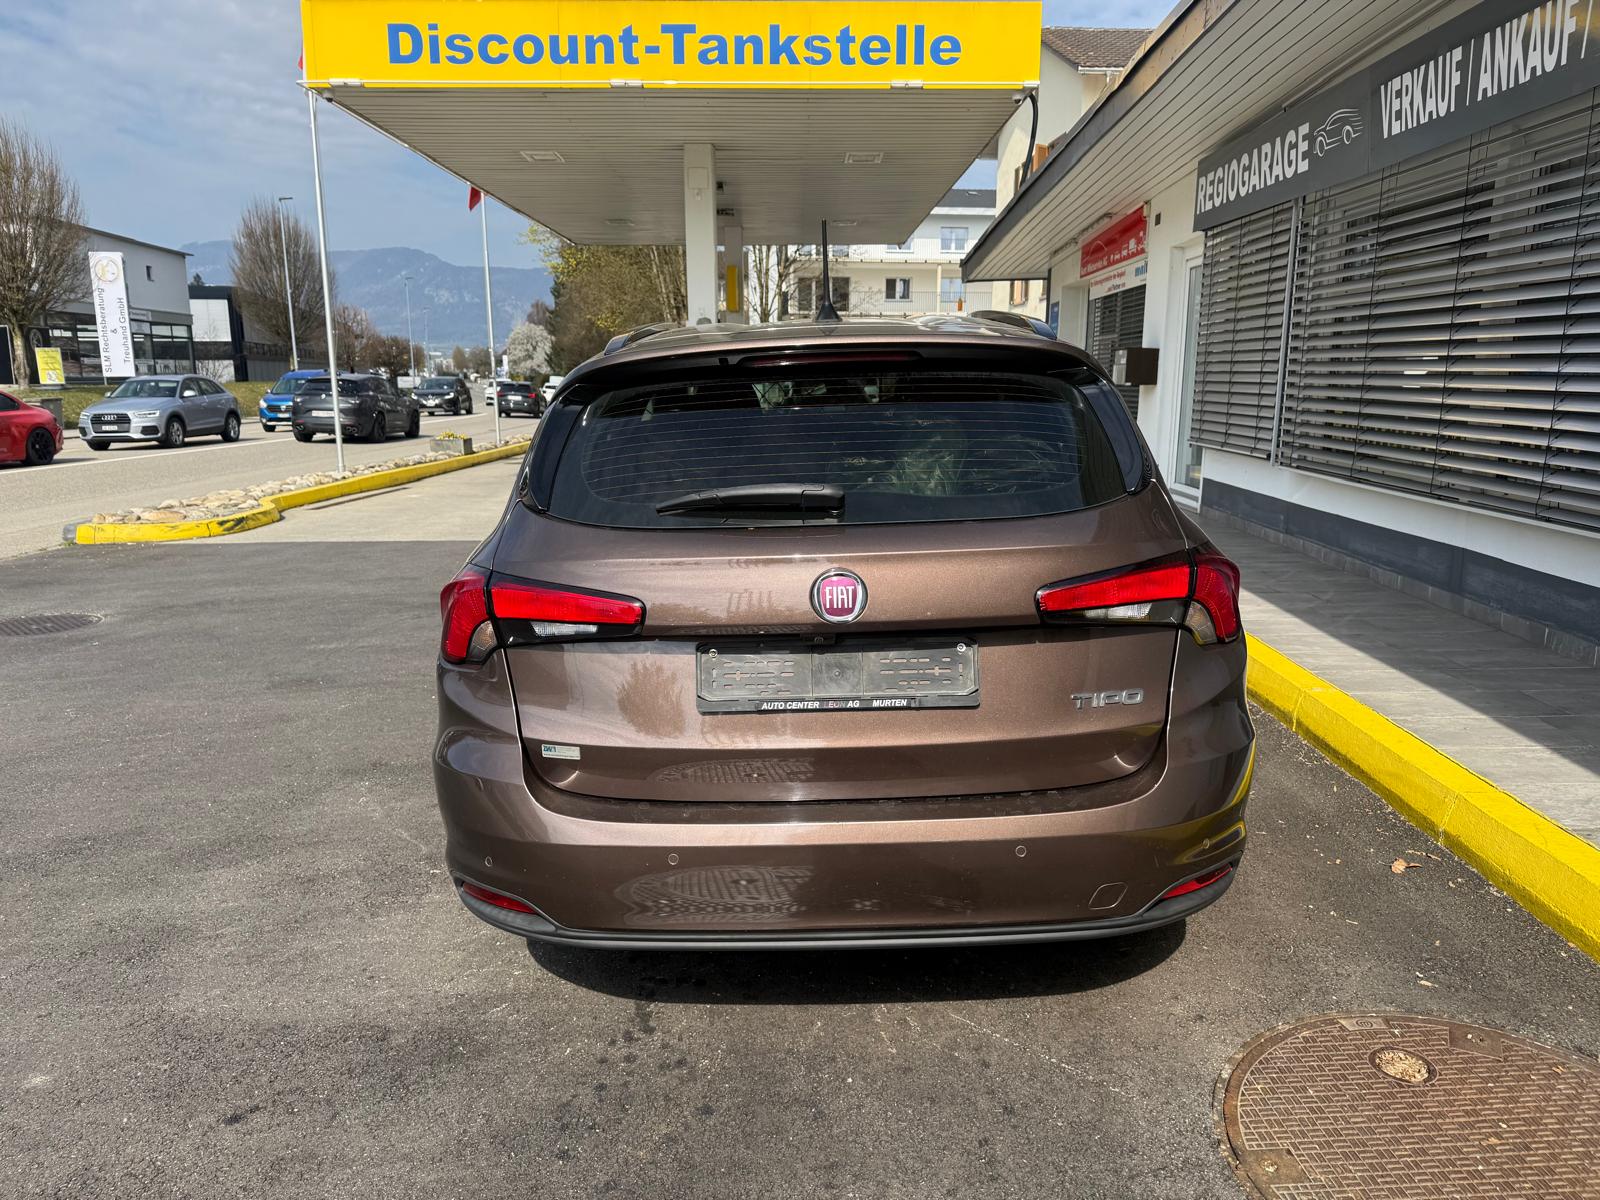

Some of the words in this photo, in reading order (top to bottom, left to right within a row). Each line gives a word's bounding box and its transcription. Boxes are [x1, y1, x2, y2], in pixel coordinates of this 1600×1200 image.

[386, 22, 963, 66] Discount-Tankstelle
[1380, 45, 1463, 139] VERKAUF
[1476, 0, 1580, 102] ANKAUF
[1196, 122, 1310, 215] REGIOGARAGE
[97, 287, 110, 353] Rechtsberatung
[116, 297, 127, 324] GmbH
[119, 325, 131, 364] Treuhand
[103, 355, 112, 373] SLM
[825, 585, 855, 609] FIAT
[761, 701, 785, 710] AUTO
[786, 700, 820, 710] CENTER
[846, 699, 860, 708] AG
[872, 698, 908, 708] MURTEN
[1070, 688, 1144, 711] TIPO
